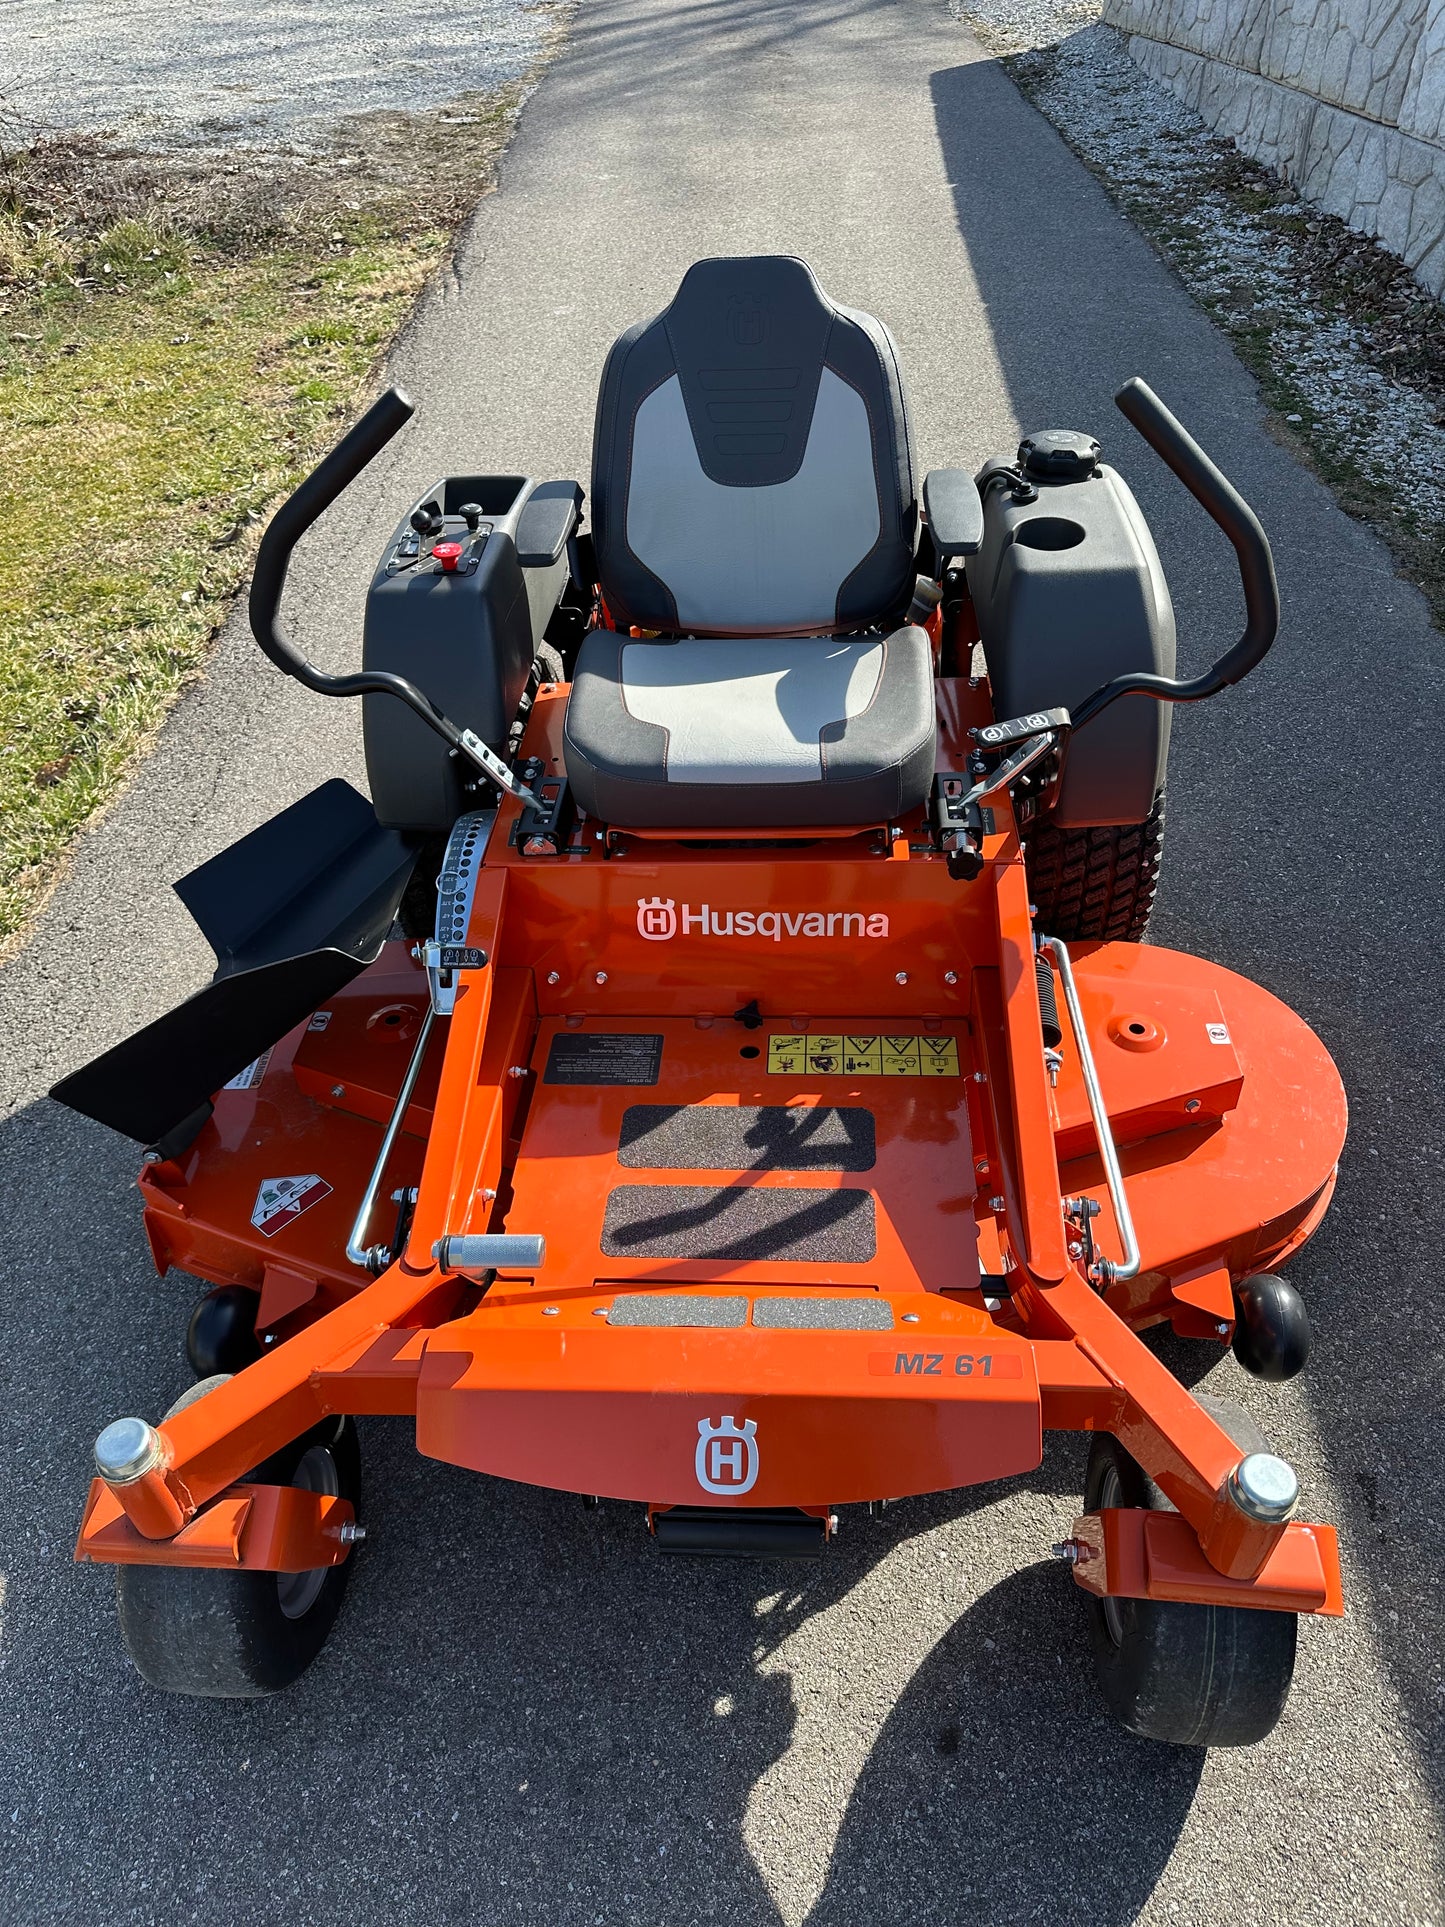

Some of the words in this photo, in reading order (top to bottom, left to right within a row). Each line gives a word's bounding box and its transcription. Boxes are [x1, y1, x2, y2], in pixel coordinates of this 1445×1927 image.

[681, 903, 889, 942] Husqvarna
[894, 1353, 944, 1375] MZ
[954, 1354, 993, 1377] 61
